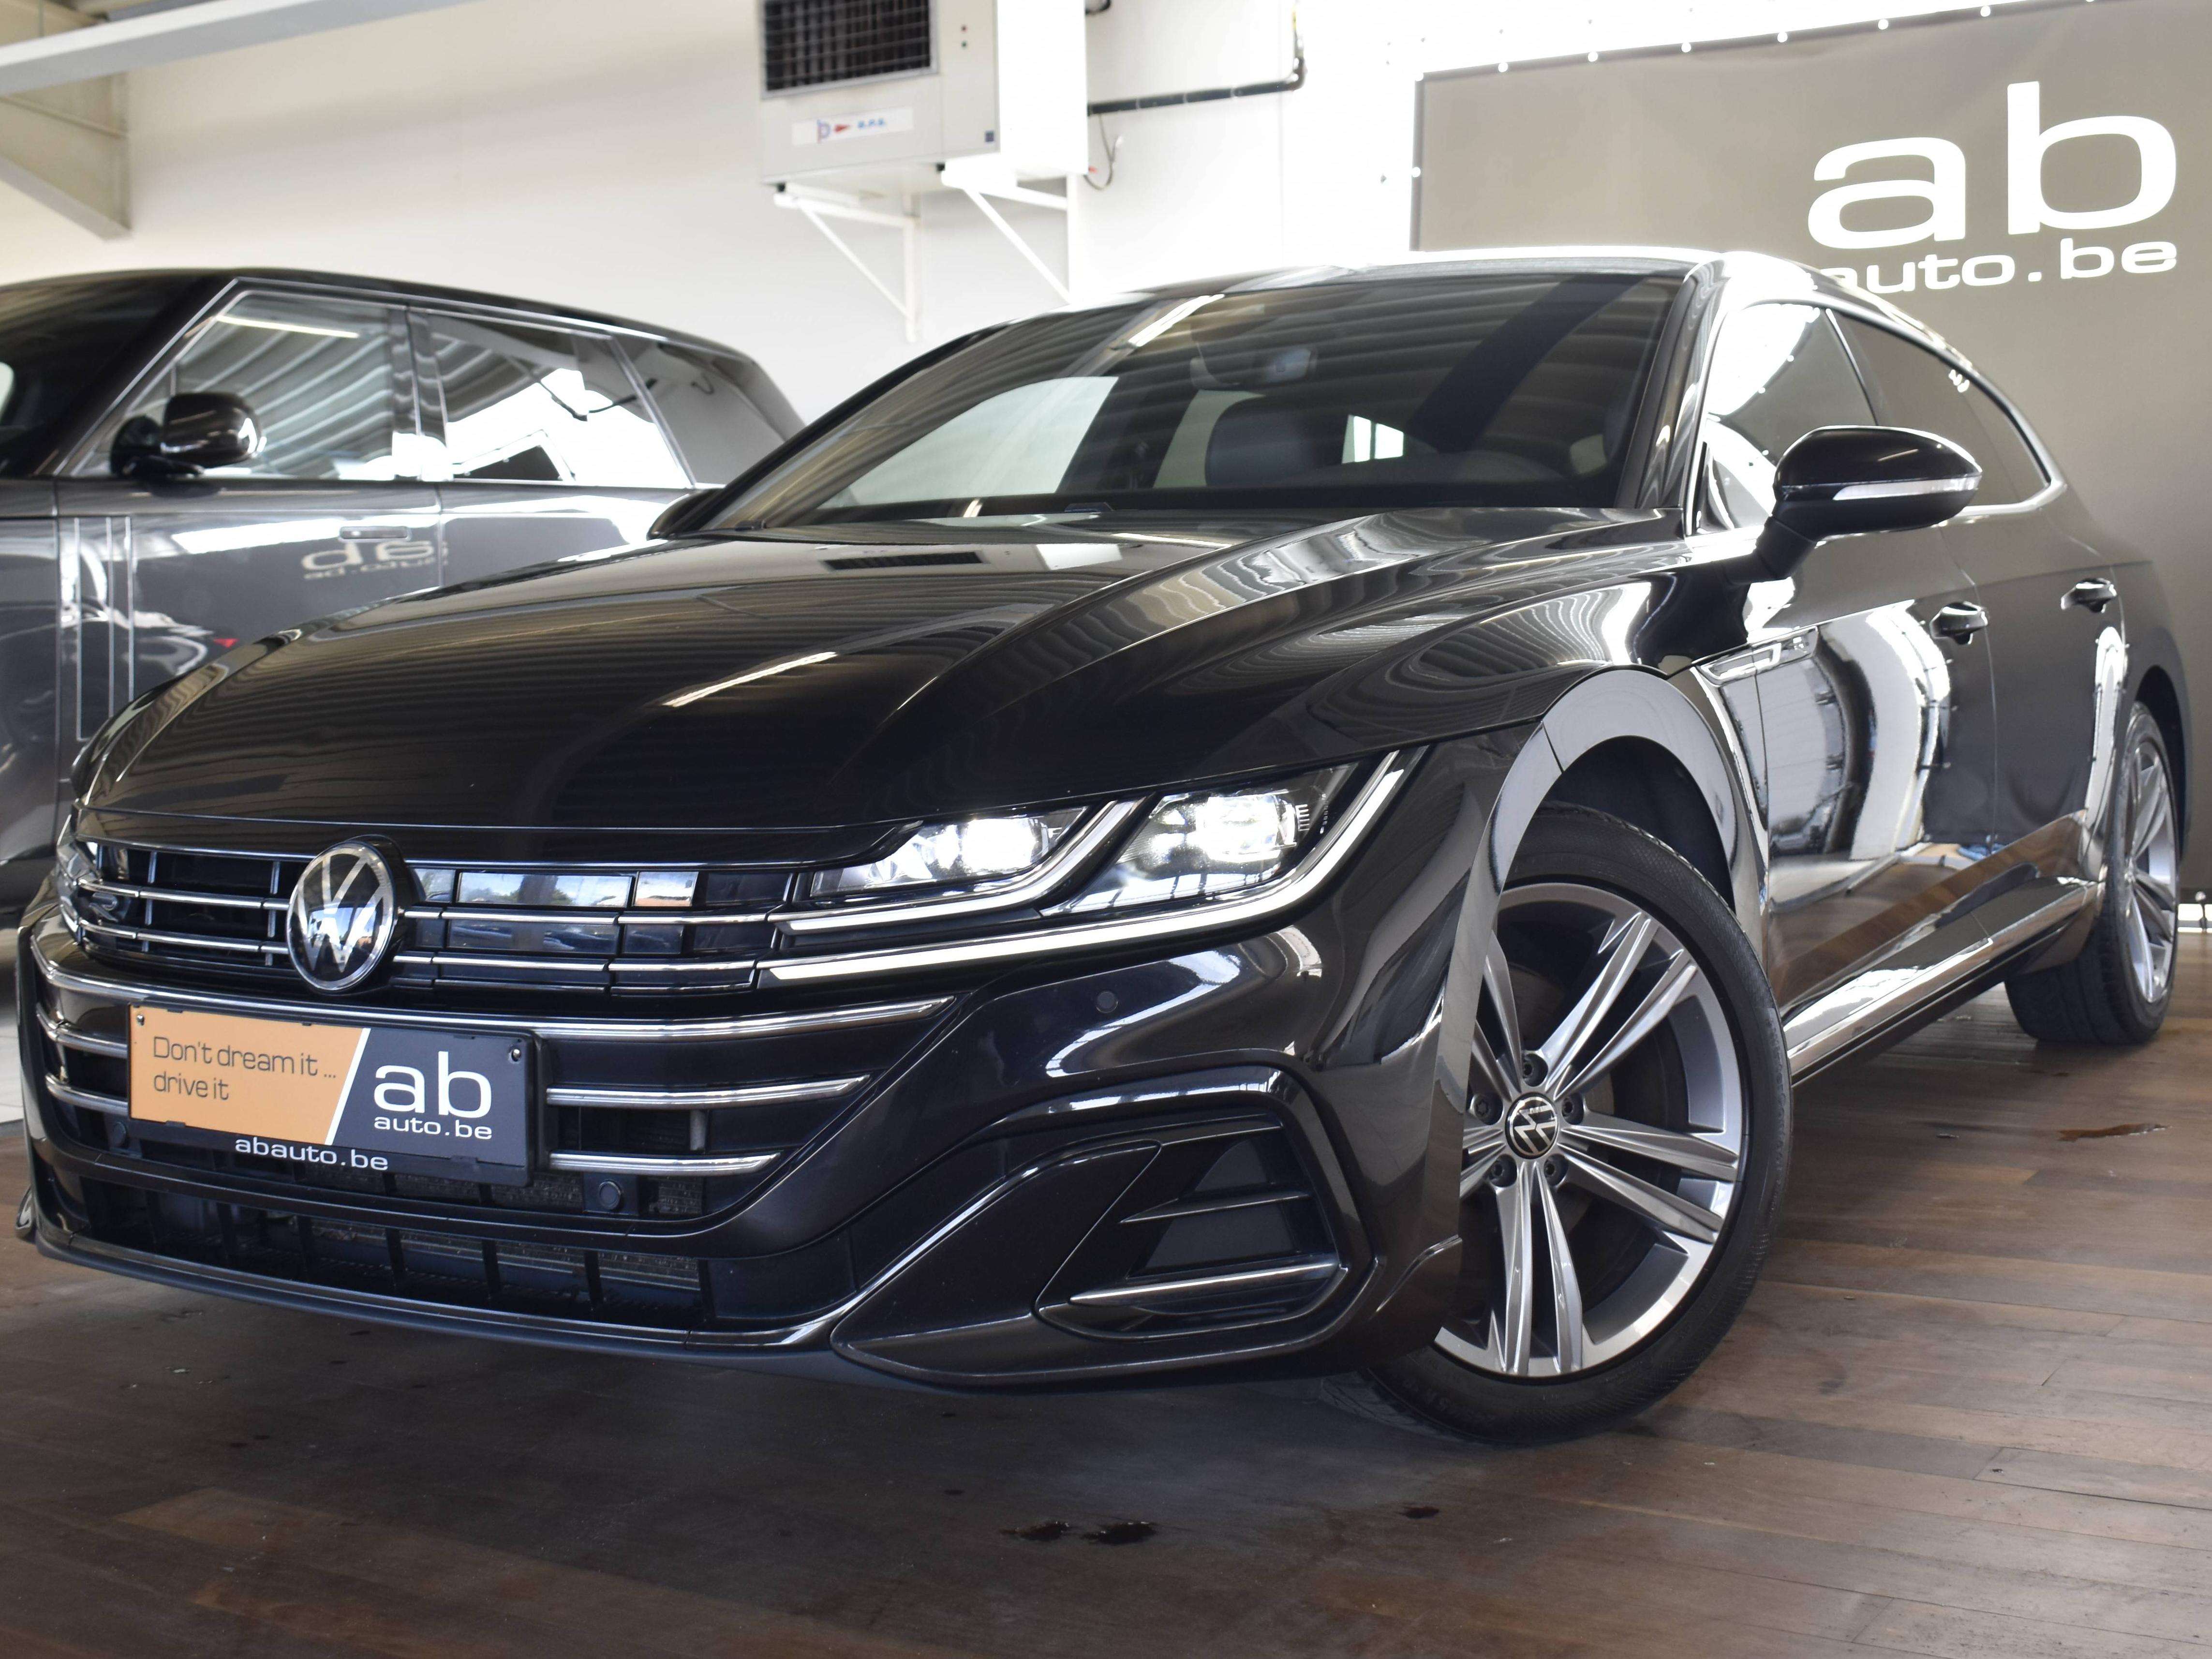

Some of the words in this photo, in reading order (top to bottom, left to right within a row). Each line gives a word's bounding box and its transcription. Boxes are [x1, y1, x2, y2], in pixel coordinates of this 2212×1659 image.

[1808, 81, 2176, 249] ab
[153, 1036, 212, 1064] Don't
[217, 1045, 294, 1074] dream
[300, 1053, 317, 1076] it
[154, 1071, 208, 1098] drive
[213, 1077, 229, 1101] it
[374, 1051, 492, 1118] ab
[374, 1116, 492, 1140] auto.be
[235, 1136, 389, 1171] abauto.be
